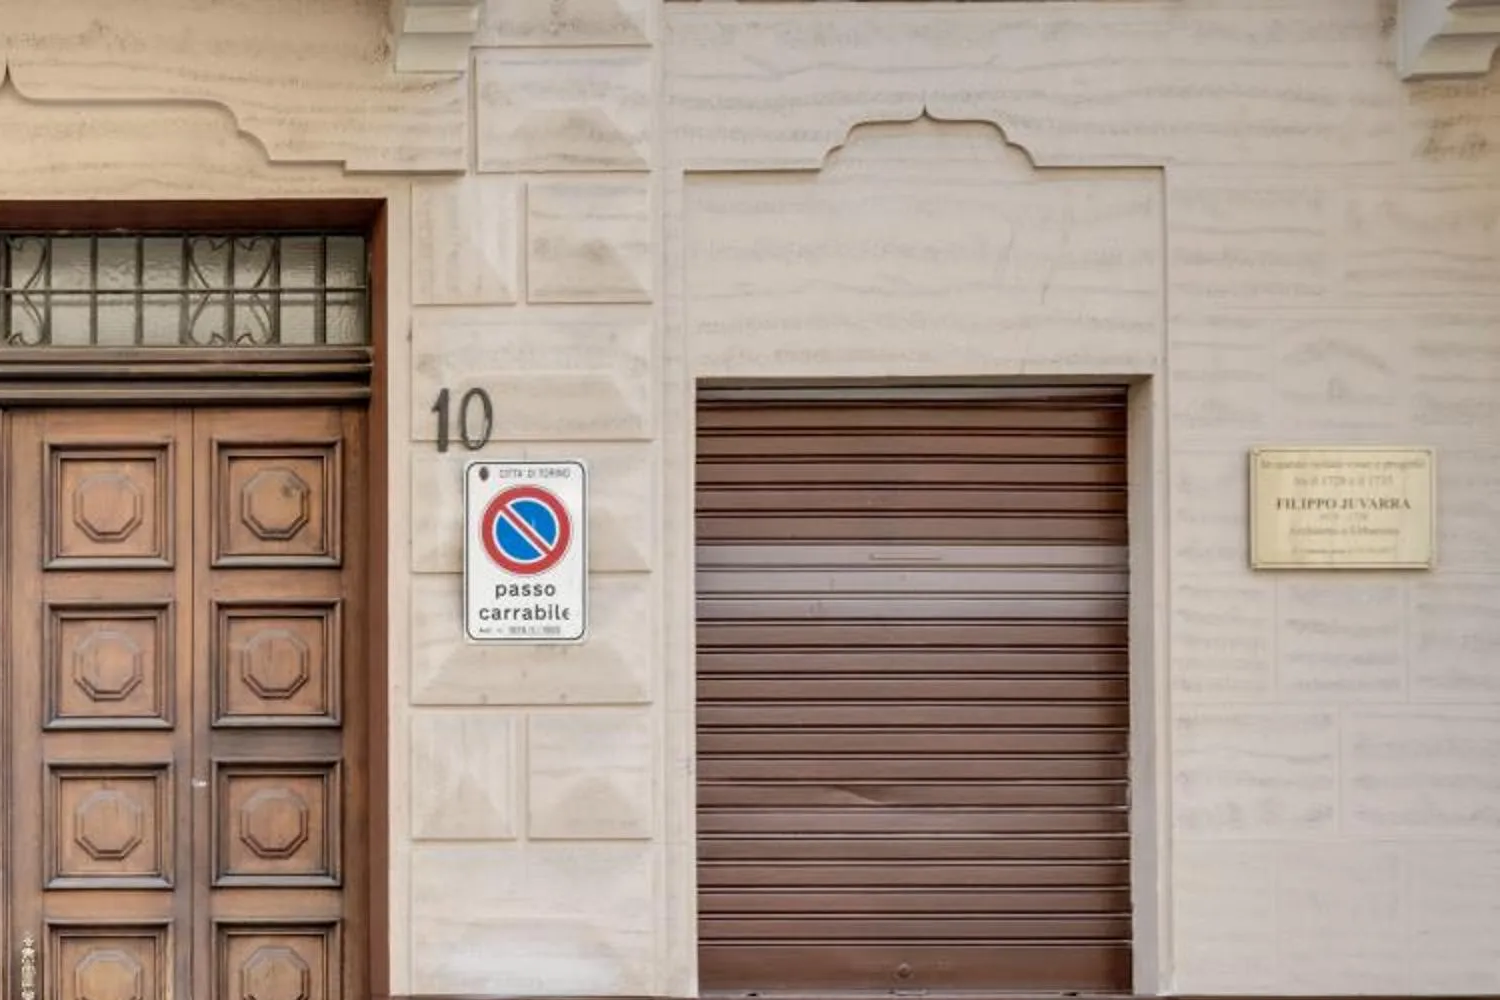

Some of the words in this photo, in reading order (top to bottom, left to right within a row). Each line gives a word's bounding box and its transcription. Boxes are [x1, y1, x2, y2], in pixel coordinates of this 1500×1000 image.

[431, 387, 493, 452] 10
[1277, 497, 1338, 511] FILIPPO
[1340, 497, 1412, 511] JUVARRA
[495, 583, 556, 600] passo
[479, 604, 571, 621] carrabile
